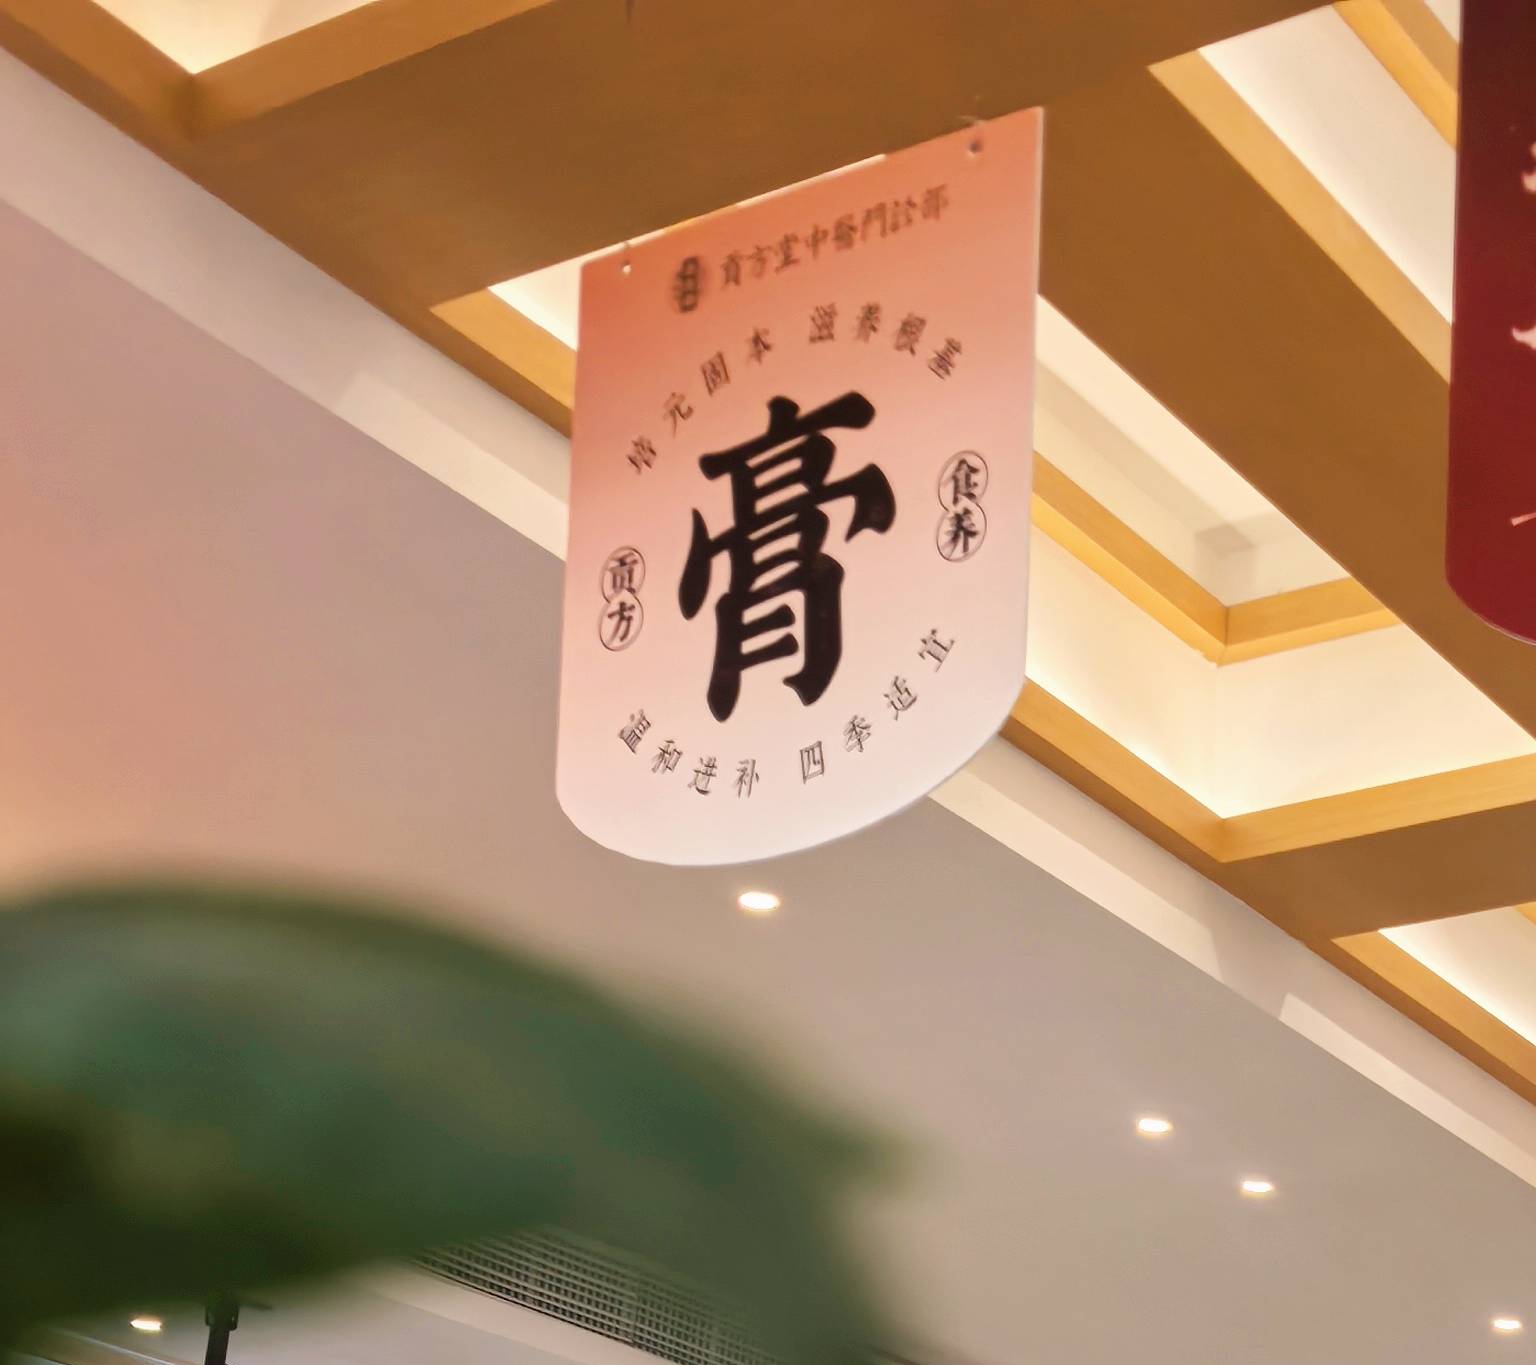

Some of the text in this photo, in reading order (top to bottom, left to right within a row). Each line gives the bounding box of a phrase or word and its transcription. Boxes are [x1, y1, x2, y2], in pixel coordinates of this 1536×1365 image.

[678, 391, 896, 722] 膏
[941, 459, 984, 555] 食养
[602, 555, 642, 641] 贡方
[617, 629, 955, 799] 温和进补 四季适宜
